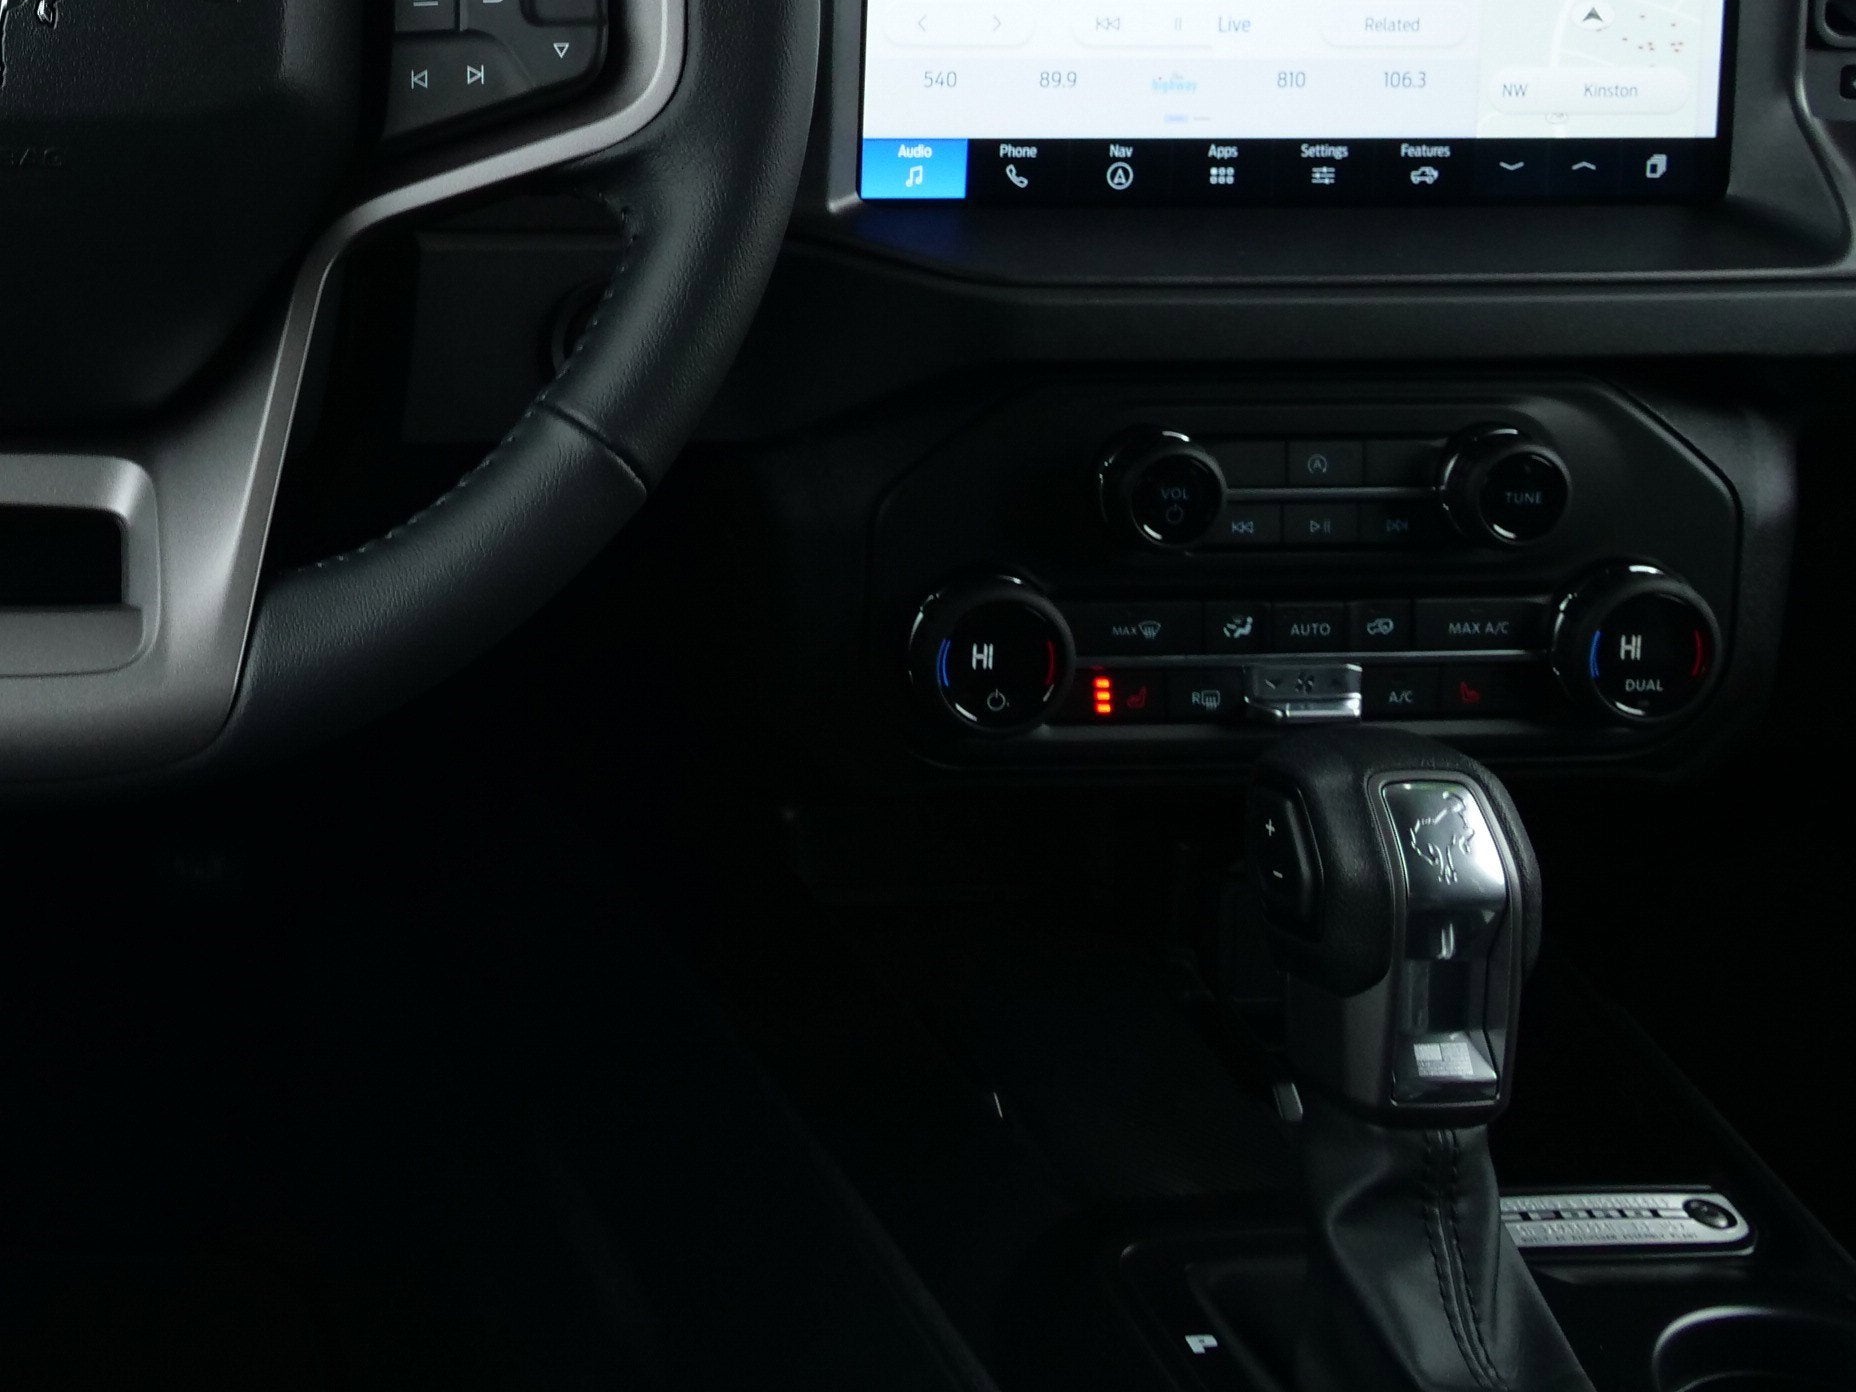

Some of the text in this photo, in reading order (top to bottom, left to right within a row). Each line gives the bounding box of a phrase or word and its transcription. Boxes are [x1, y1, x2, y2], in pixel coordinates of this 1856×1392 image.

[1217, 15, 1252, 34] Live
[1364, 17, 1421, 34] Related
[923, 70, 958, 89] 540
[1038, 70, 1078, 89] 89.9
[1276, 70, 1307, 90] 810
[1383, 71, 1427, 90] 106.3
[1501, 83, 1528, 98] NW
[1583, 83, 1639, 99] Kinston
[897, 143, 933, 159] Audio
[999, 143, 1038, 159] Phone
[1109, 143, 1134, 158] Nav
[1207, 143, 1239, 161] Apps
[1300, 143, 1349, 160] Settings
[1400, 143, 1451, 159] Features
[1504, 490, 1545, 506] TUNE
[1112, 625, 1138, 638] MAX
[1289, 622, 1332, 637] AUTO
[1448, 621, 1510, 637] MAX A/C
[1619, 633, 1642, 661] HI
[970, 642, 995, 672] HI
[1624, 678, 1665, 693] DUAL
[1388, 689, 1415, 704] A/C
[1184, 1333, 1219, 1355] P
